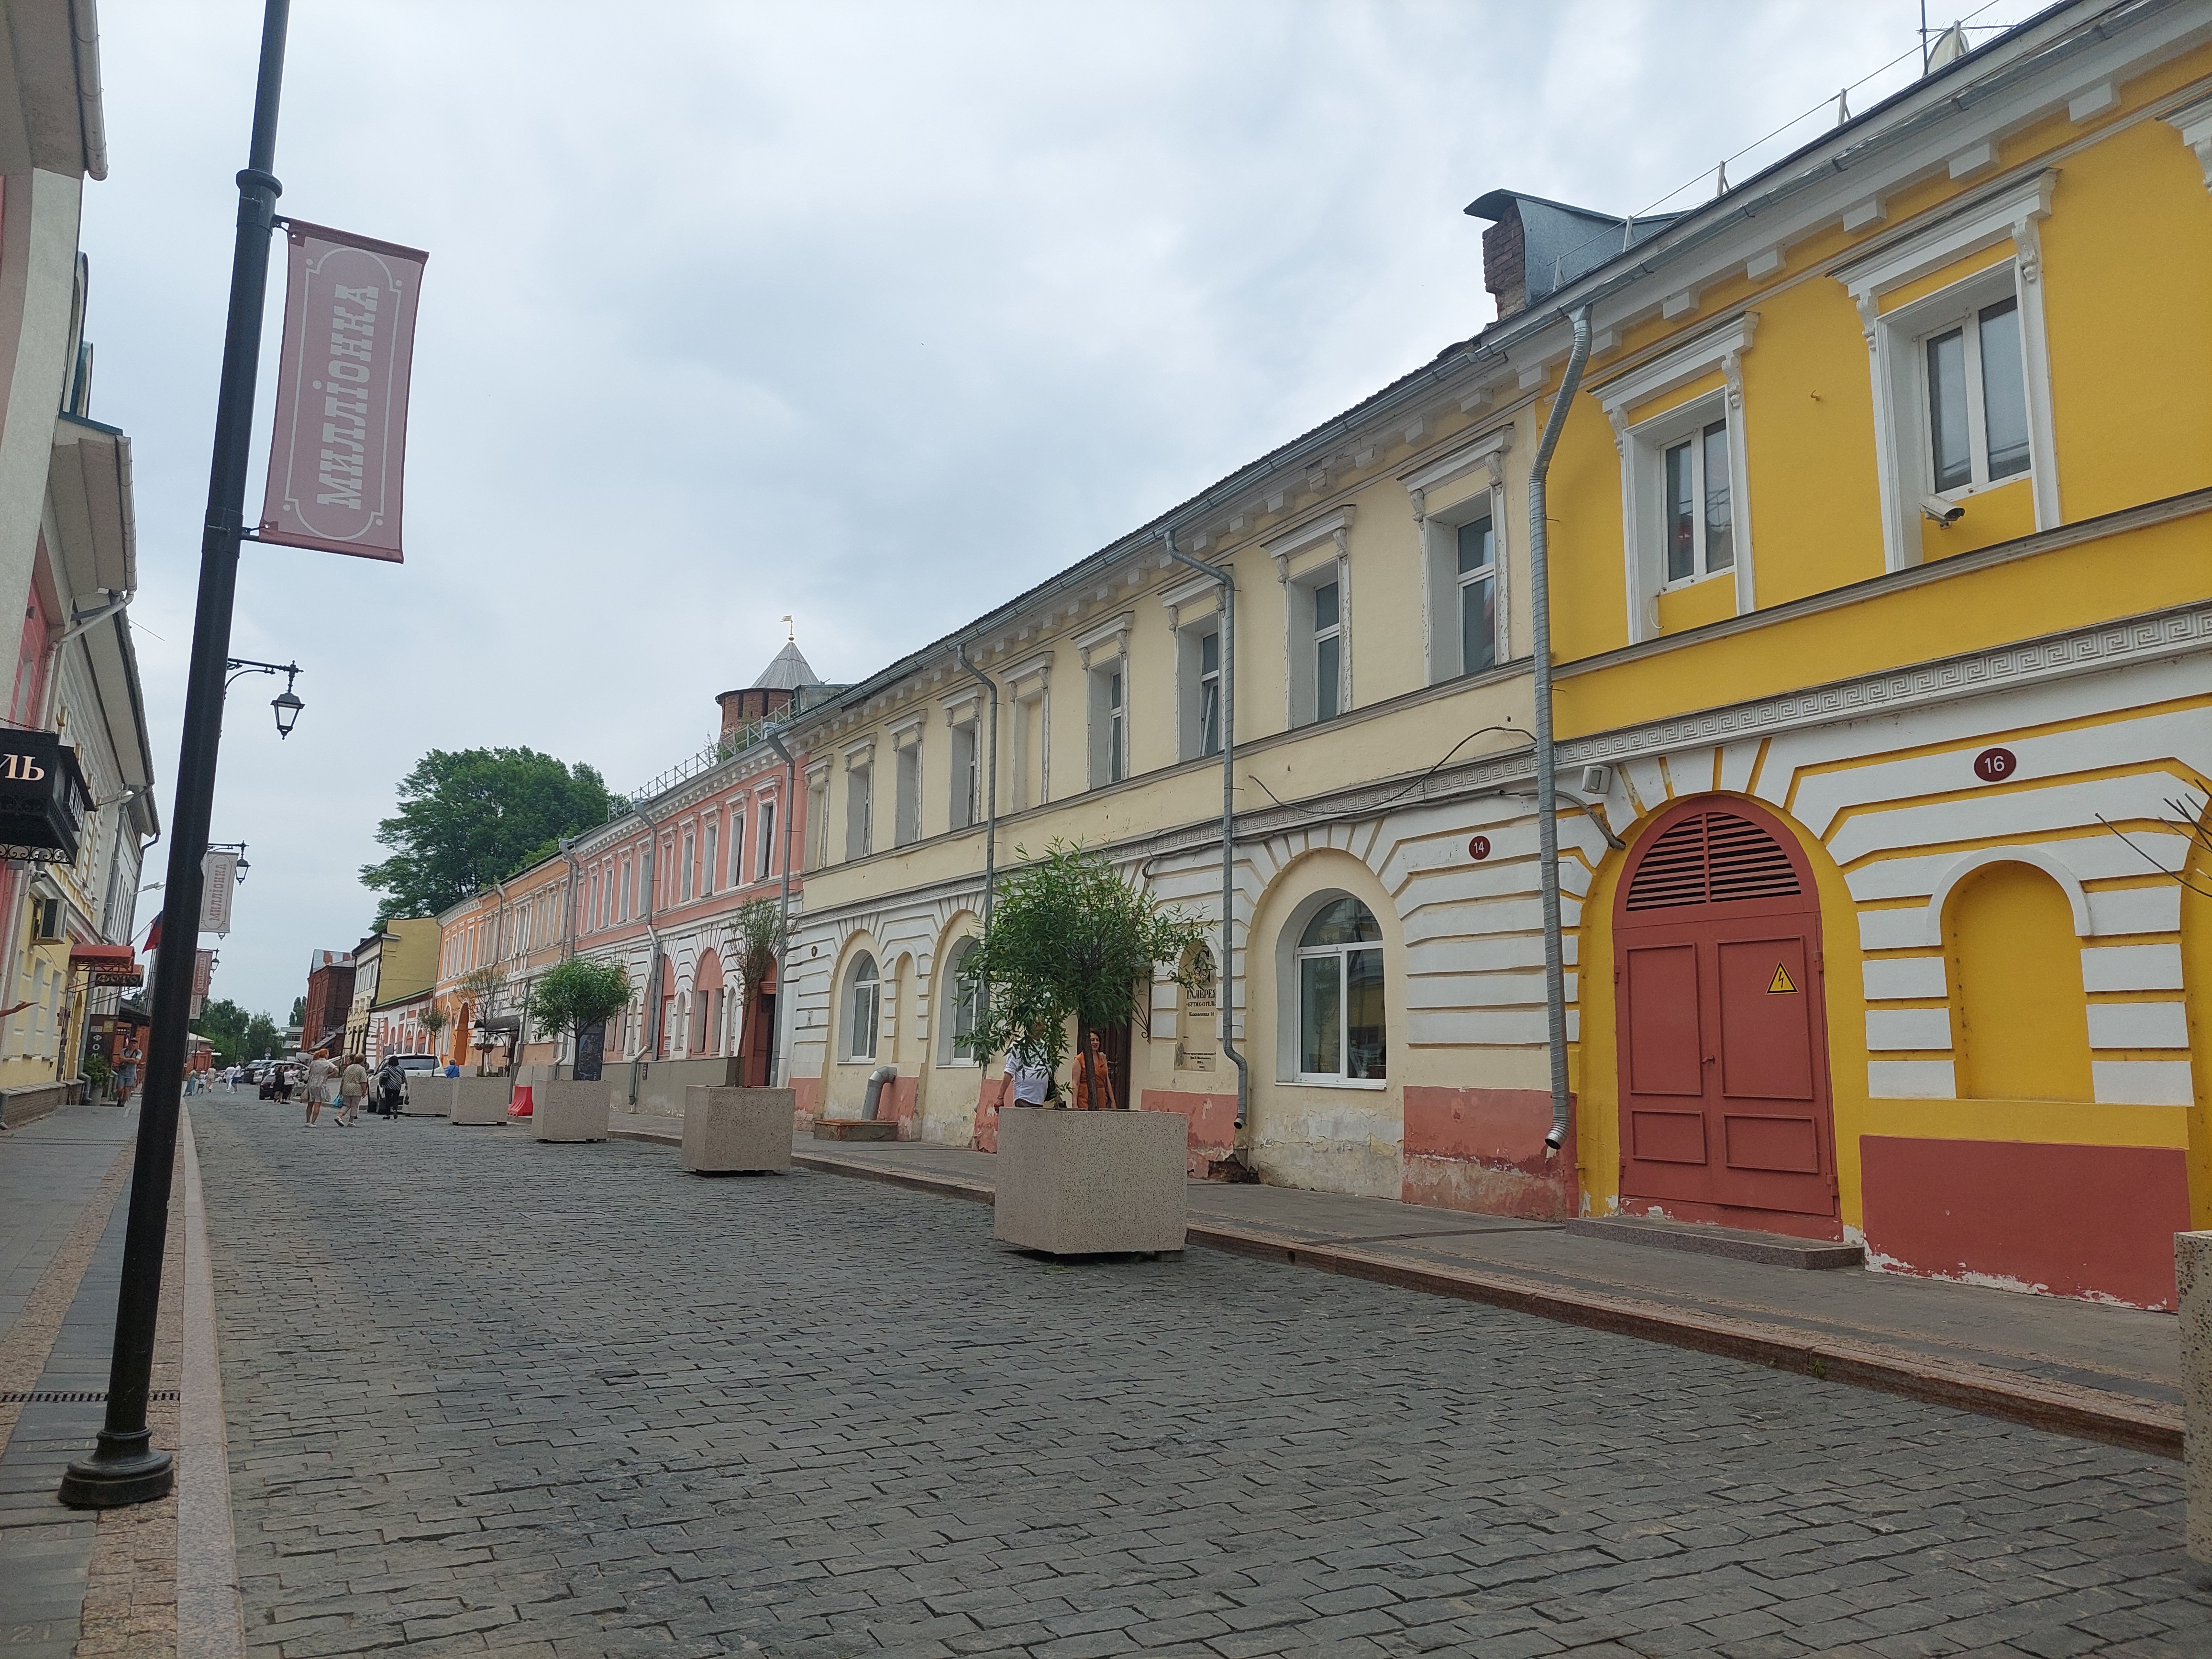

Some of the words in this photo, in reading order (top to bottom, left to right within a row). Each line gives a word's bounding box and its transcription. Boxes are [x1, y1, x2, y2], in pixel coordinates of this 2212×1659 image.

[312, 284, 379, 510] МИЛЛІОНКА
[1984, 755, 2005, 774] 16
[1474, 841, 1484, 854] 14
[1186, 988, 1217, 999] ГАЛЕРЕЯ
